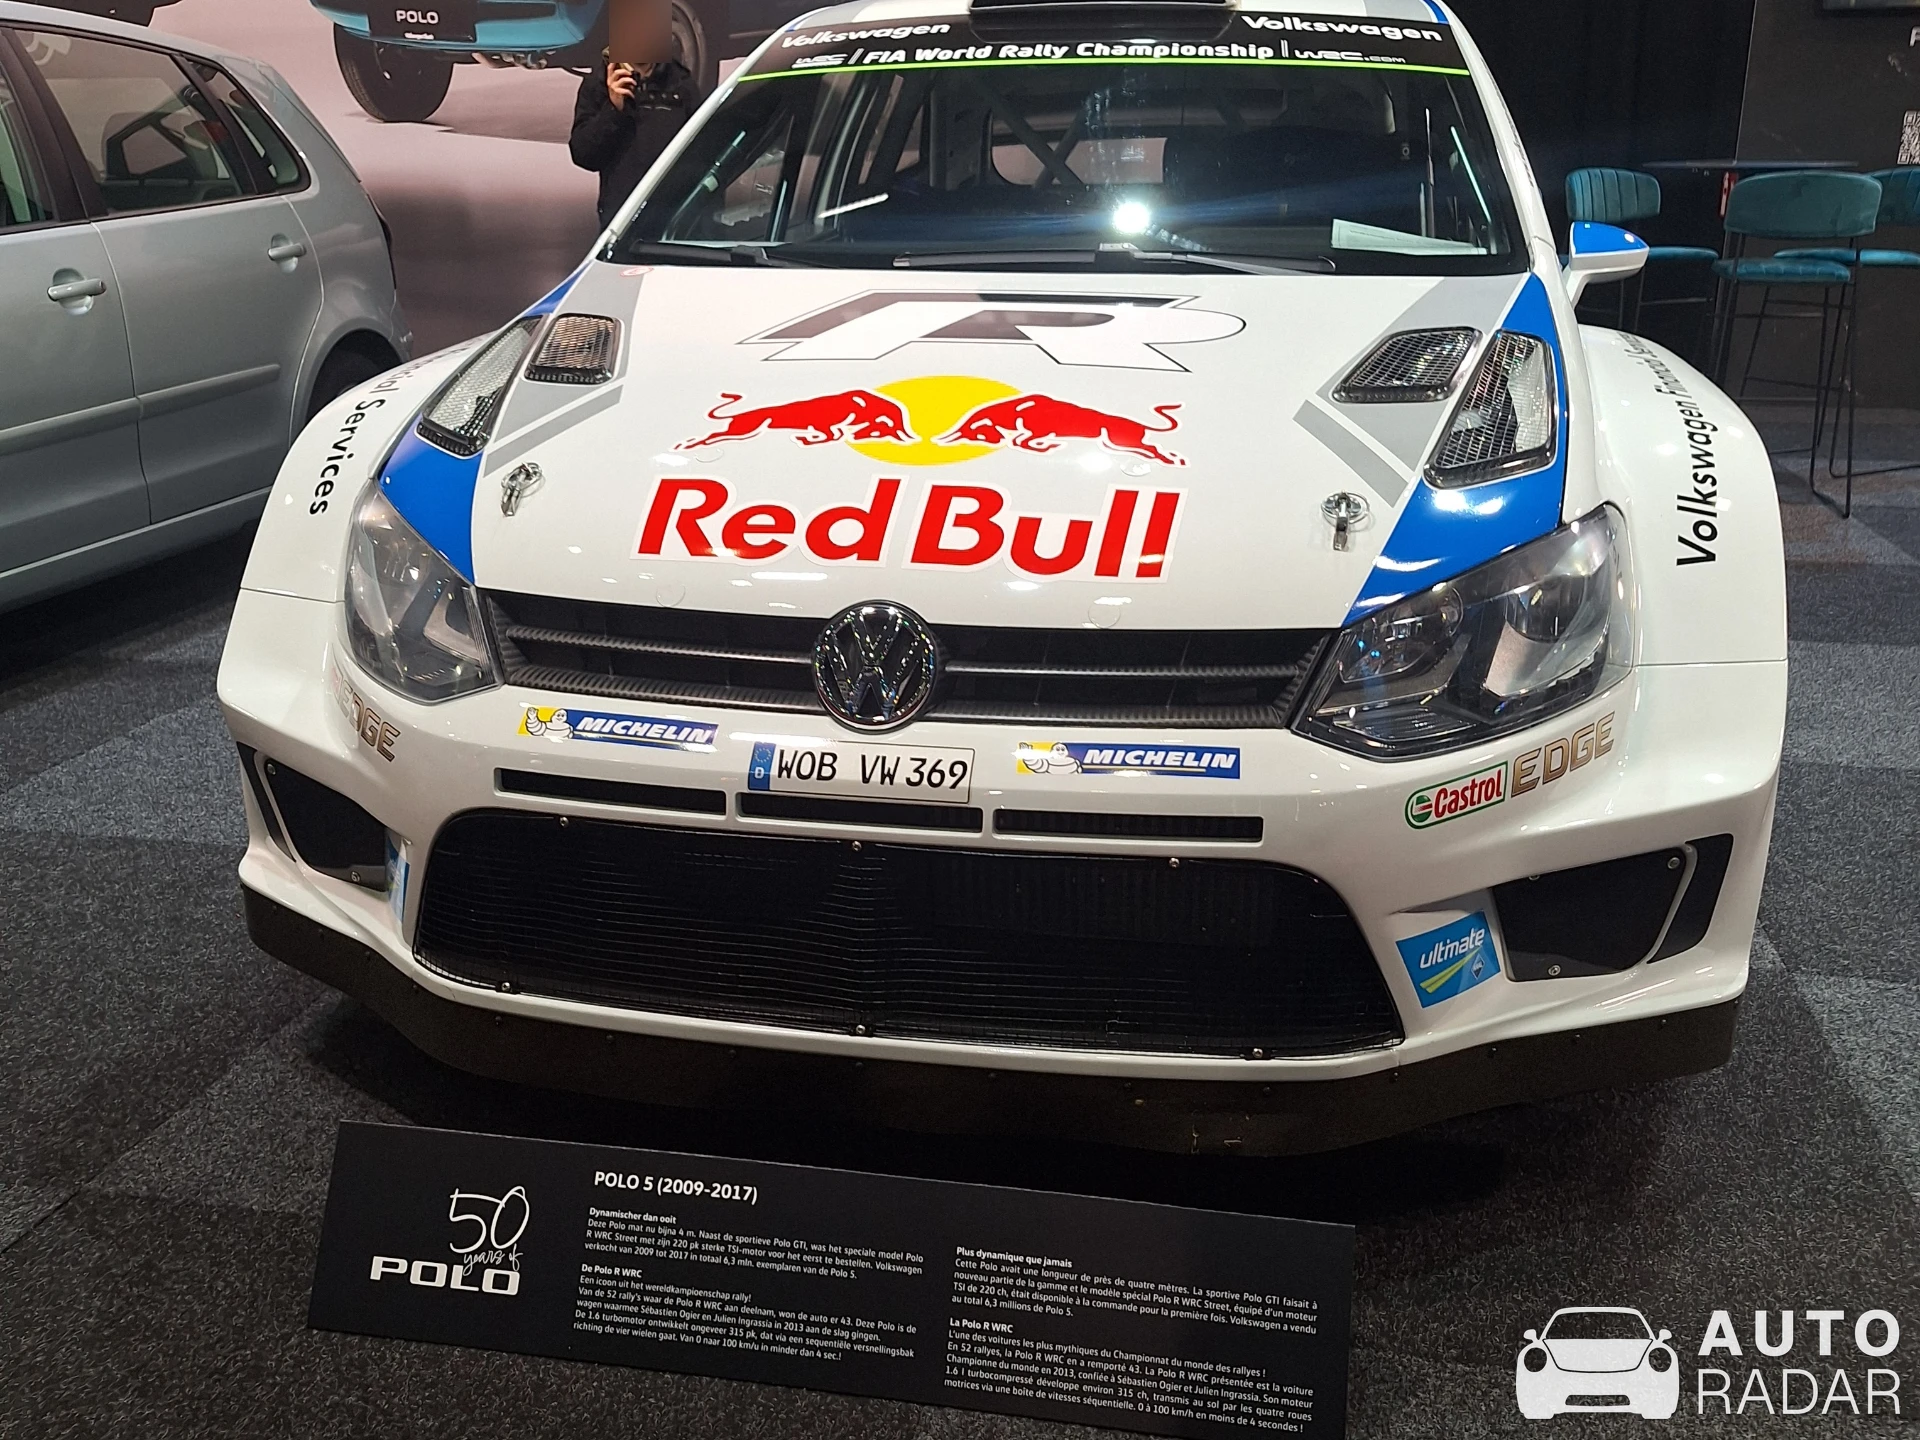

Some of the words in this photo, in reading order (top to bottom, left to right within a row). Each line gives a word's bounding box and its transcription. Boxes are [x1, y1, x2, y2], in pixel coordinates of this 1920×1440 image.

[395, 9, 439, 25] POLO
[1241, 15, 1443, 41] Volkswagen
[781, 24, 951, 48] Volkswagen
[862, 50, 907, 65] FIA
[914, 45, 993, 62] World
[999, 43, 1070, 59] Rally
[1076, 42, 1274, 60] Championship
[309, 398, 387, 516] Services
[1675, 400, 1719, 567] Volkswagen
[636, 477, 902, 562] Red
[911, 484, 1181, 579] Bull
[339, 679, 401, 762] EDGE
[576, 716, 713, 743] MICHELIN
[777, 749, 838, 781] WOB
[861, 754, 901, 786] VW
[905, 757, 968, 790] 369
[1083, 749, 1238, 769] MICHELIN
[1510, 710, 1616, 799] EDGE
[754, 767, 764, 779] D
[1433, 768, 1503, 819] Castrol
[1418, 926, 1485, 969] ultimate
[594, 1170, 639, 1189] POLO
[642, 1175, 653, 1190] 5
[657, 1177, 757, 1205] (2009-2017)
[449, 1185, 530, 1254] 50
[589, 1207, 641, 1219] Dynamischer
[642, 1212, 658, 1221] dan
[659, 1214, 676, 1224] ooit
[587, 1218, 606, 1228] Deze
[608, 1220, 625, 1230] Polo
[657, 1225, 676, 1236] bijna
[698, 1229, 720, 1240] Naast
[723, 1232, 733, 1241] de
[735, 1235, 770, 1245] sportieve
[773, 1237, 790, 1247] Polo
[810, 1243, 825, 1251] was
[828, 1244, 841, 1253] het
[844, 1247, 875, 1257] speciale
[878, 1251, 903, 1260] model
[905, 1252, 923, 1262] Polo
[956, 1246, 974, 1256] Plus
[975, 1248, 1024, 1262] dynamique
[1025, 1256, 1042, 1265] que
[1042, 1256, 1072, 1267] jamais
[369, 1255, 521, 1296] POLO
[462, 1248, 507, 1276] years
[508, 1243, 524, 1272] of
[581, 1263, 592, 1272] De
[593, 1264, 612, 1274] Polo
[621, 1267, 642, 1278] WRC
[584, 1242, 617, 1252] verkocht
[634, 1246, 653, 1255] 2009
[655, 1249, 666, 1257] tot
[668, 1249, 688, 1259] 2017
[699, 1254, 721, 1263] totaal
[723, 1256, 735, 1265] 6,3
[756, 1261, 801, 1271] exemplaren
[818, 1266, 828, 1275] de
[830, 1267, 847, 1277] Polo
[579, 1274, 594, 1283] Een
[595, 1276, 616, 1286] icoon
[618, 1280, 628, 1288] uit
[630, 1280, 643, 1289] het
[645, 1284, 730, 1300] wereldkampioenschap
[731, 1292, 751, 1303] rally!
[955, 1258, 977, 1268] Cette
[979, 1260, 997, 1271] Polo
[1000, 1265, 1020, 1273] avait
[1041, 1268, 1077, 1280] longueur
[1080, 1273, 1091, 1282] de
[1093, 1275, 1111, 1284] près
[1114, 1277, 1125, 1286] de
[1127, 1280, 1155, 1289] quatre
[1192, 1286, 1202, 1295] La
[1205, 1289, 1240, 1300] sportive
[1243, 1292, 1262, 1302] Polo
[1265, 1295, 1279, 1304] GTI
[1283, 1296, 1308, 1308] faisait
[963, 1295, 982, 1304] total
[984, 1297, 997, 1307] 6,3
[999, 1300, 1031, 1311] millions
[1032, 1303, 1043, 1312] de
[1045, 1304, 1063, 1314] Polo
[575, 1309, 585, 1318] De
[588, 1310, 599, 1319] 1.6
[602, 1313, 646, 1324] turbomotor
[647, 1319, 688, 1330] ontwikkelt
[690, 1324, 726, 1334] ongeveer
[728, 1326, 743, 1336] 315
[759, 1331, 772, 1340] dat
[775, 1333, 786, 1341] via
[788, 1335, 803, 1343] een
[805, 1337, 851, 1349] sequentiële
[853, 1344, 913, 1357] versnellingsbak
[949, 1317, 959, 1326] La
[961, 1318, 981, 1329] Polo
[991, 1322, 1013, 1333] WRC
[972, 1332, 986, 1342] des
[988, 1335, 1020, 1346] voitures
[1022, 1338, 1034, 1347] les
[1036, 1340, 1053, 1350] plus
[1055, 1344, 1098, 1356] mythiques
[1100, 1348, 1111, 1357] du
[1113, 1349, 1168, 1365] Championnat
[1171, 1357, 1181, 1366] du
[1184, 1360, 1213, 1370] monde
[1215, 1363, 1230, 1372] des
[1232, 1366, 1260, 1377] rallyes
[946, 1353, 997, 1367] Championne
[998, 1360, 1009, 1369] du
[1010, 1363, 1039, 1373] monde
[1078, 1371, 1108, 1381] confiée
[1117, 1374, 1157, 1387] Sébastien
[1159, 1380, 1182, 1392] Ogier
[1193, 1385, 1218, 1395] Julien
[1263, 1393, 1279, 1403] Son
[1280, 1398, 1312, 1407] moteur
